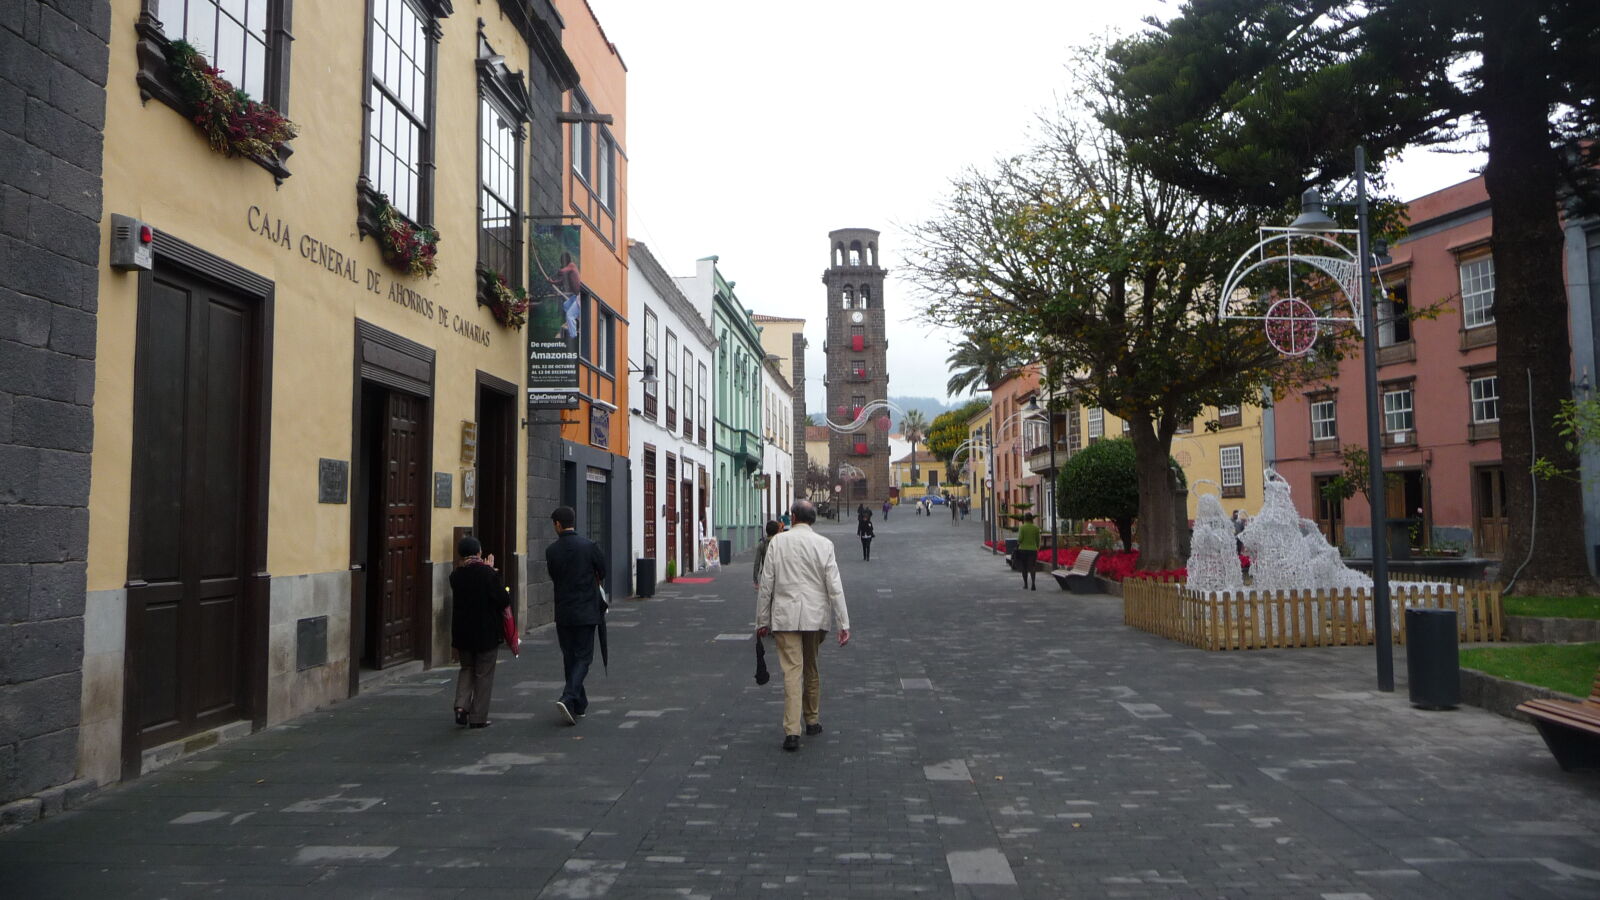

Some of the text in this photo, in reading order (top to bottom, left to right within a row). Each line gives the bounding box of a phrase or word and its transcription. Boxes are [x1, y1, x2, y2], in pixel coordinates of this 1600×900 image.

[247, 205, 491, 347] CAJA GENERAL DE AHORROS DE CANARIAS
[530, 351, 578, 360] Amazonas
